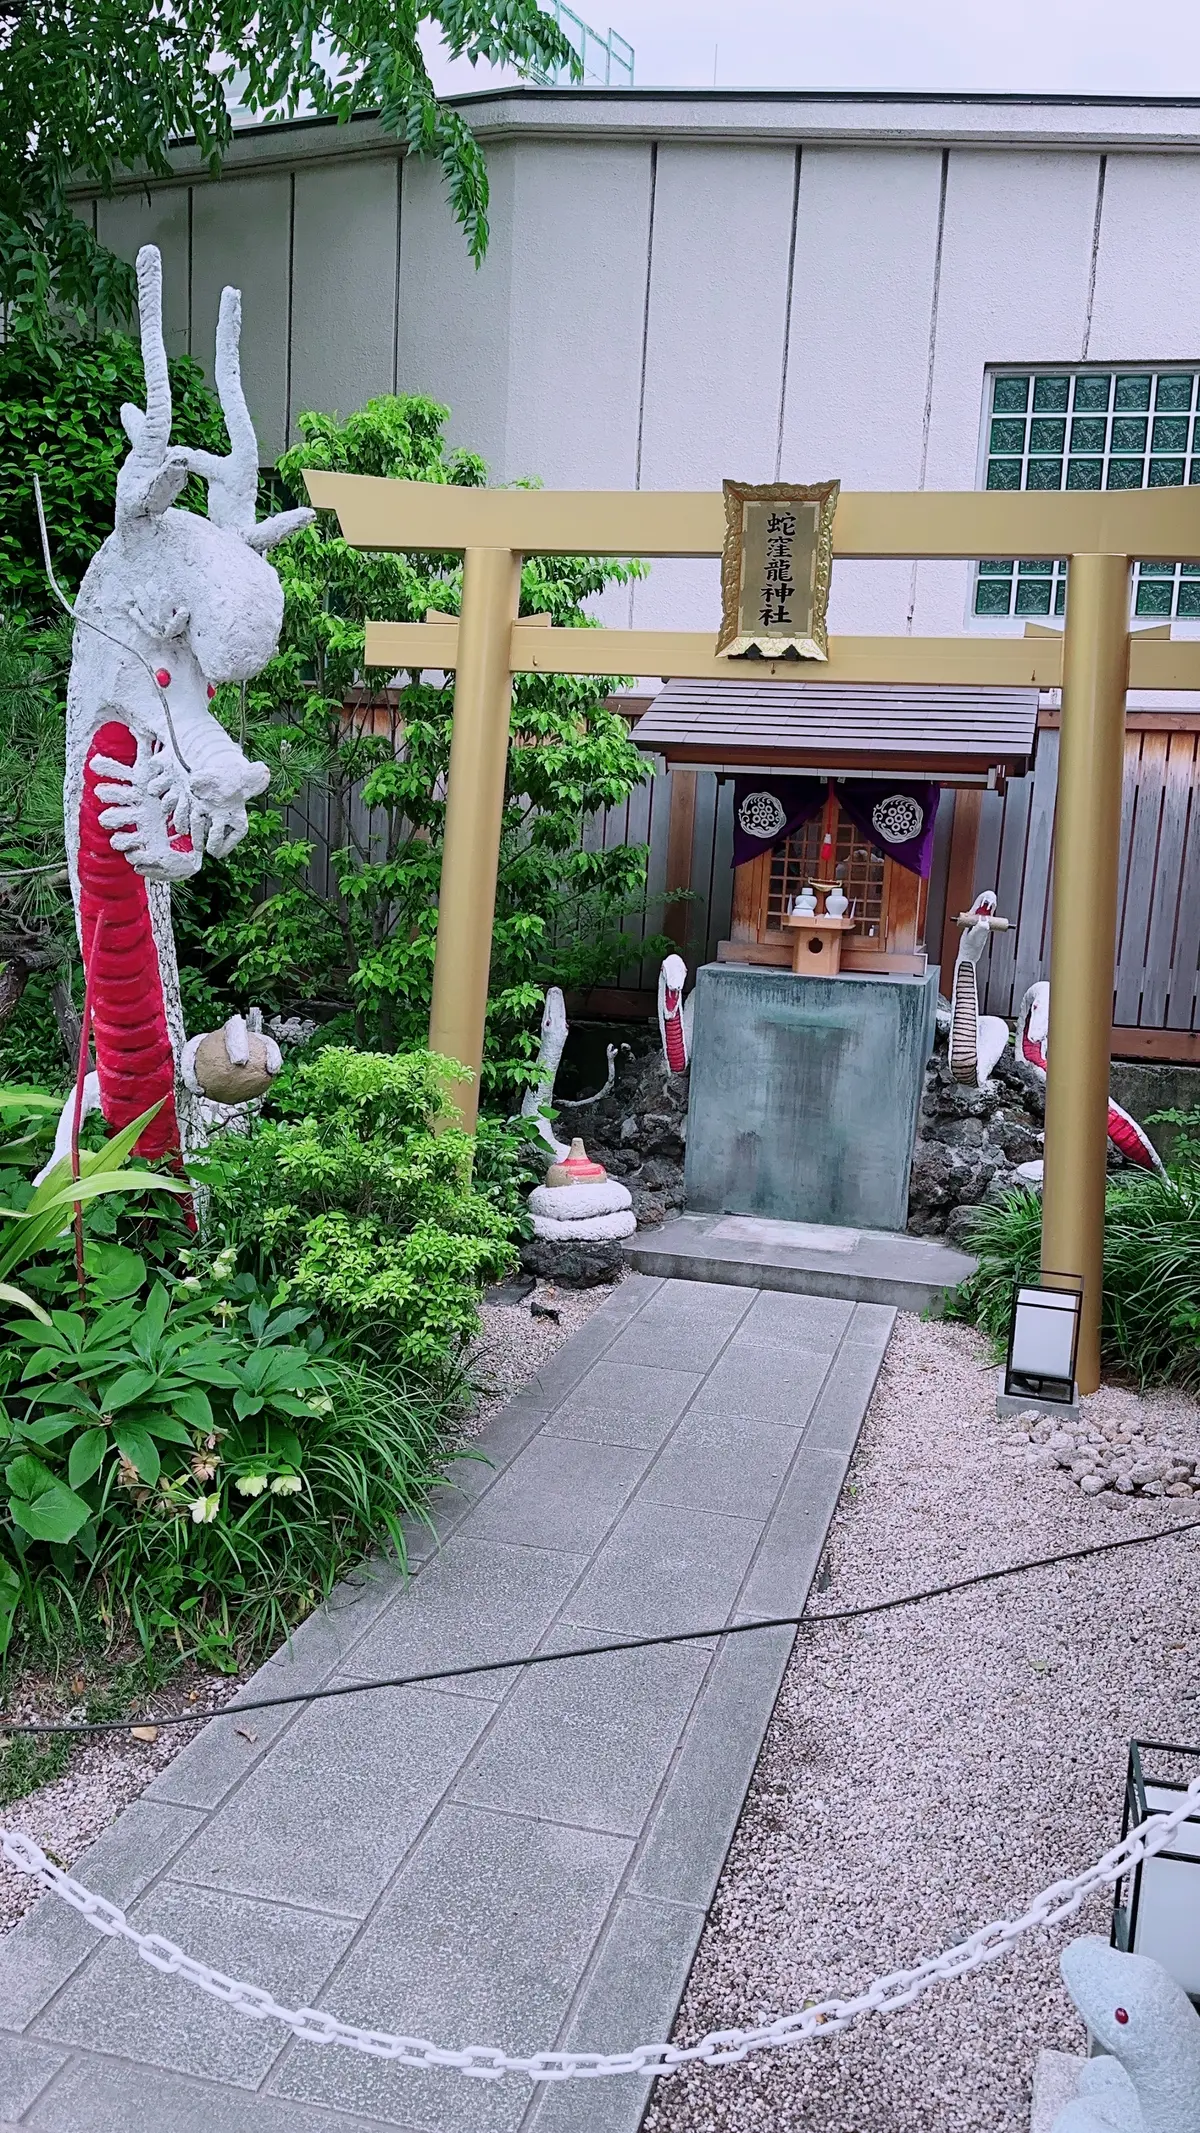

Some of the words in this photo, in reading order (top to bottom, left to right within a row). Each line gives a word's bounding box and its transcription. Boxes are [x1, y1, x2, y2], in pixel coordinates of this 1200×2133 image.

[758, 512, 796, 626] 蛇窪龍神社
